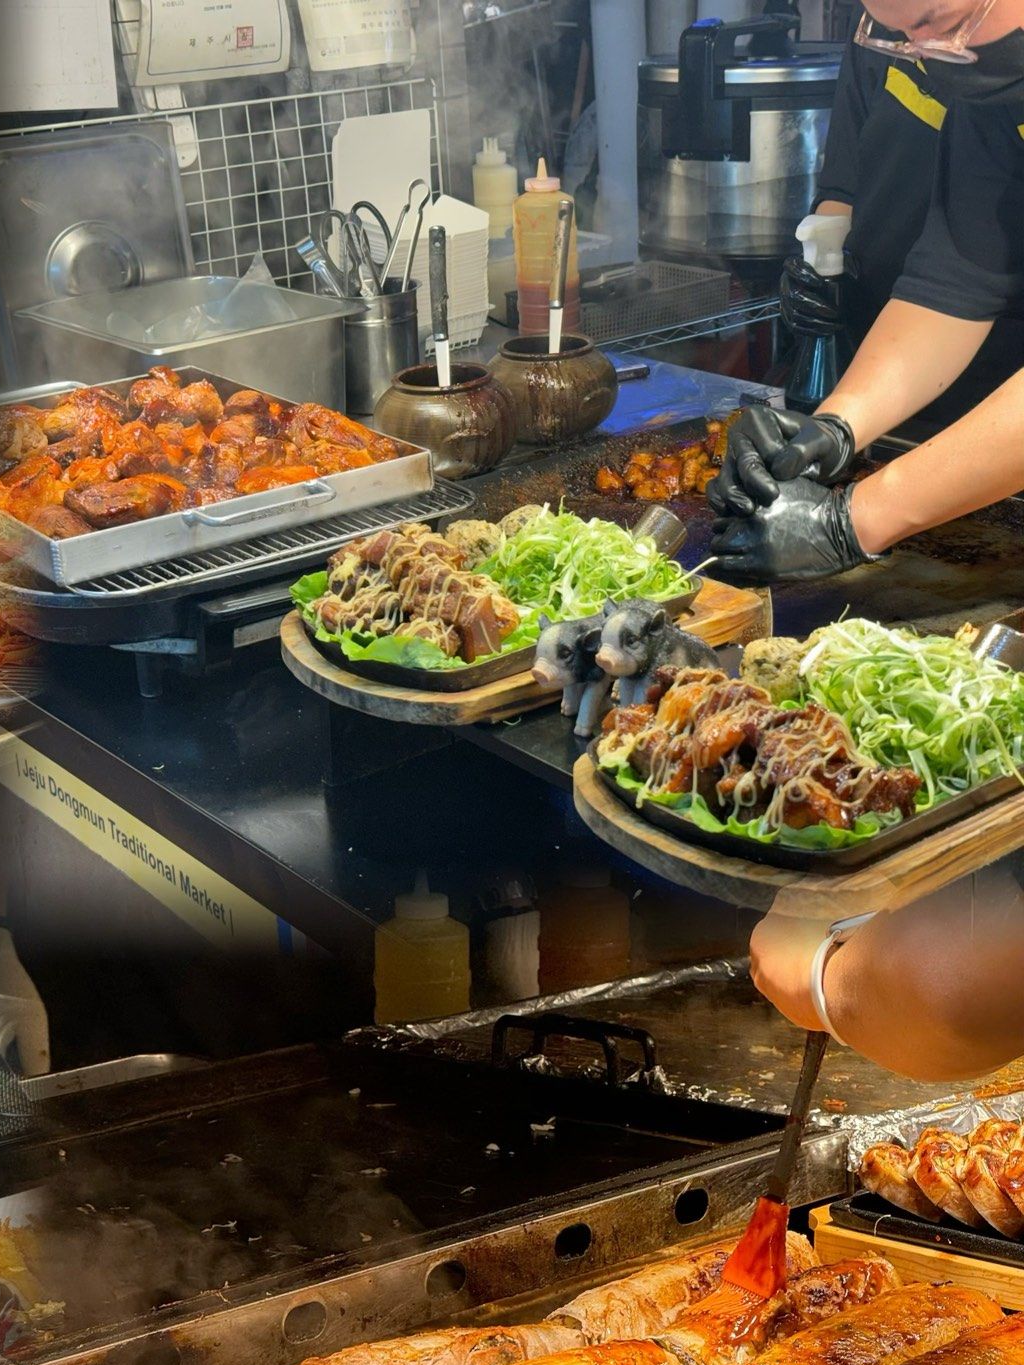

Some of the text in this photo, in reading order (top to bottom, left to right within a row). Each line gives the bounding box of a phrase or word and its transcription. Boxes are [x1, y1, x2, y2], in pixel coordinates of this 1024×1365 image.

[22, 759, 227, 925] Jeju Dongmun Traditional Market
